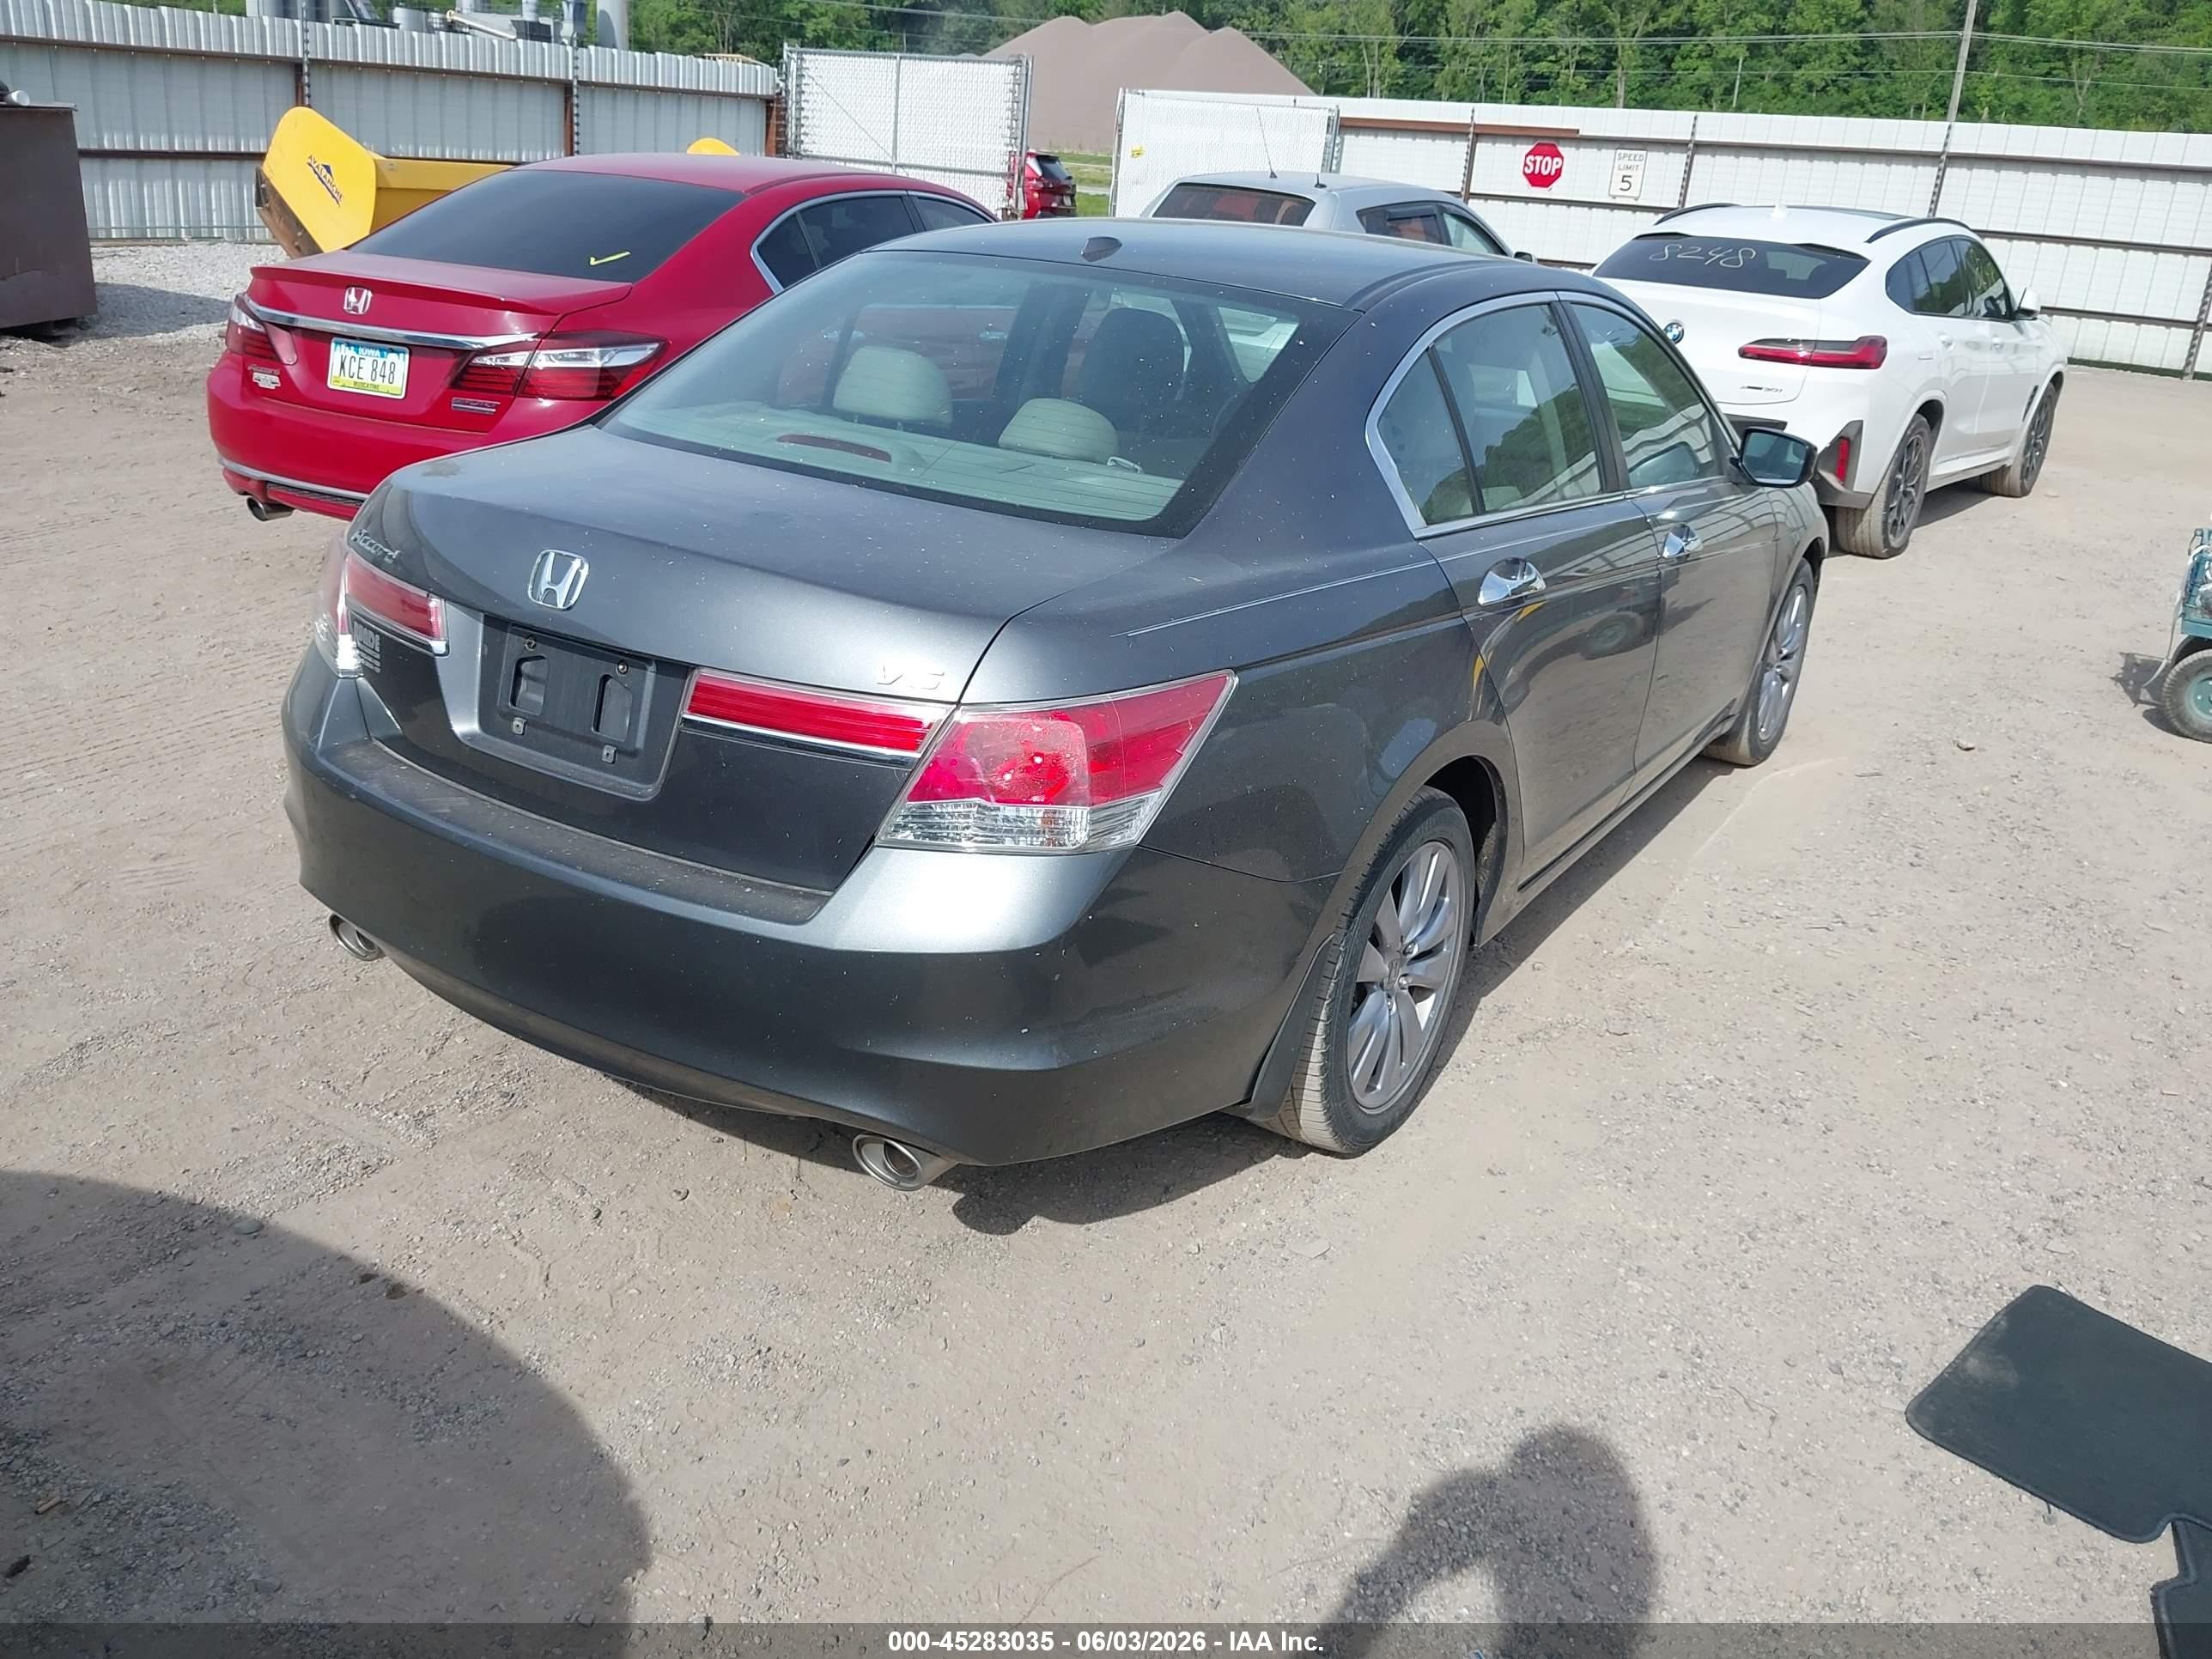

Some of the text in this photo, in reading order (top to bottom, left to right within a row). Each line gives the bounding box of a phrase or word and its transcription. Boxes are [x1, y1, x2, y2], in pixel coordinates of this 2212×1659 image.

[1523, 155, 1563, 176] STOP
[1617, 152, 1644, 162] SPEED
[1619, 175, 1633, 191] 5
[1649, 243, 1757, 269] 8248
[359, 345, 381, 357] IOWA
[339, 354, 397, 385] KCE 848
[351, 528, 402, 564] Accord
